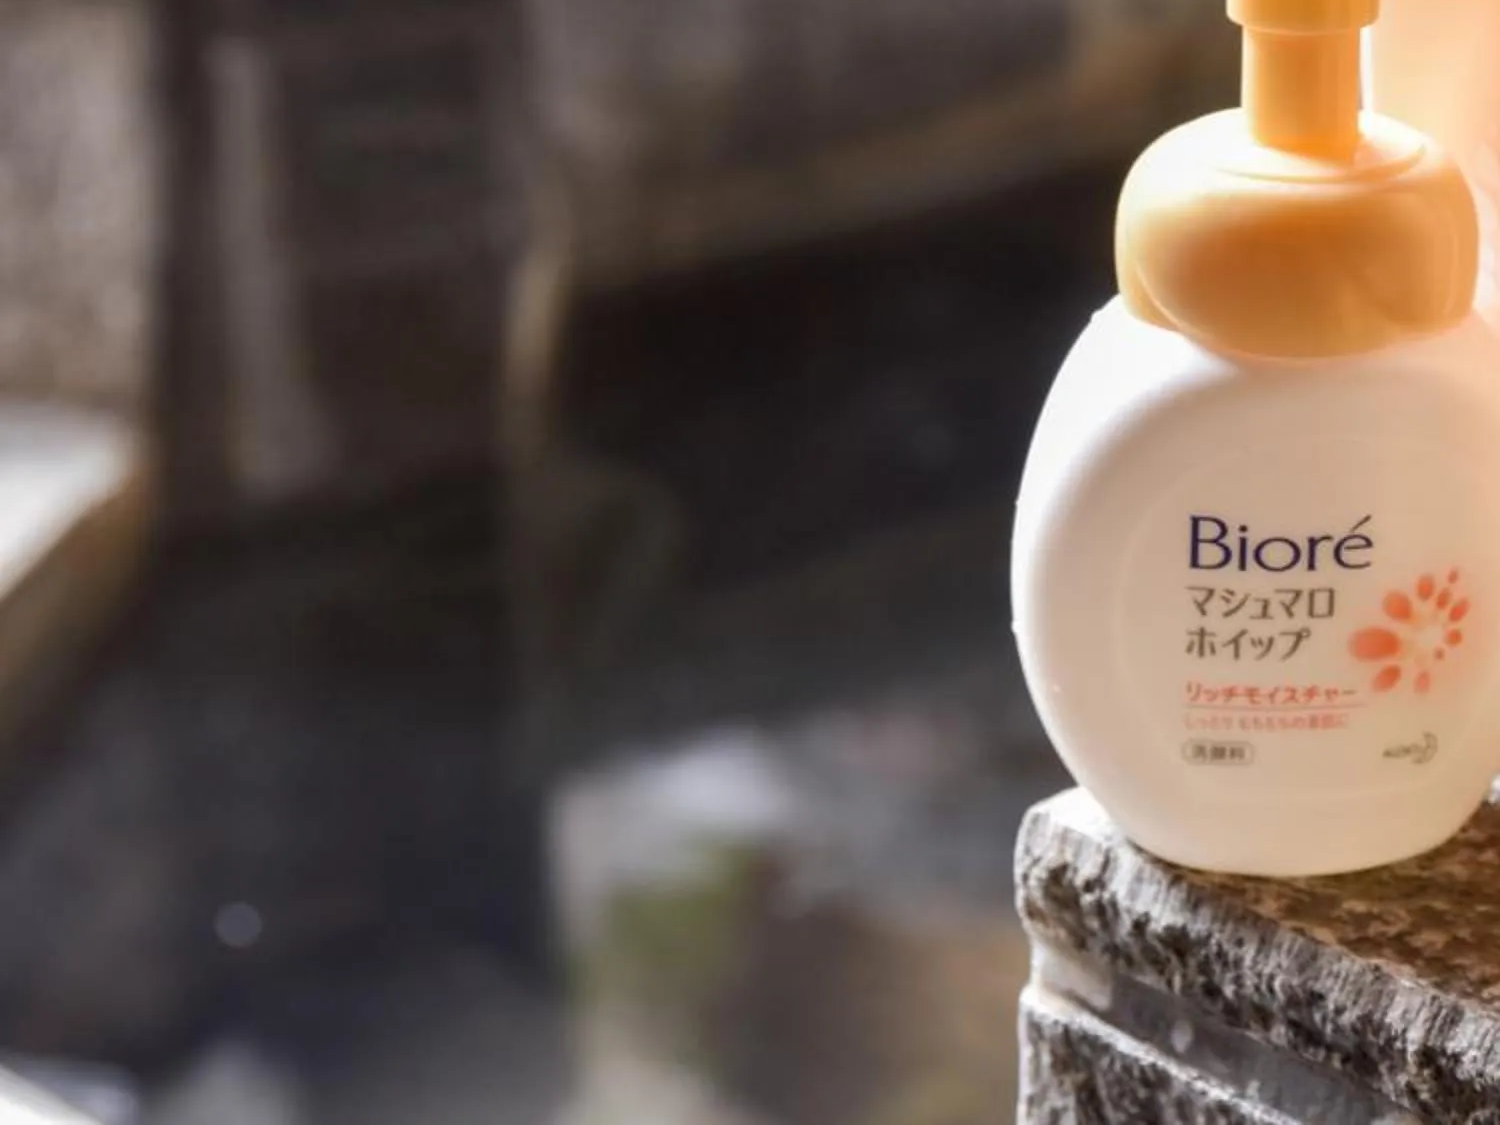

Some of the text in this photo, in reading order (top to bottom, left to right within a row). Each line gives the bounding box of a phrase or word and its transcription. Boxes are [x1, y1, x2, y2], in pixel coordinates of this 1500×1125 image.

[1188, 513, 1374, 573] Bioré
[1185, 585, 1336, 620] マシュマロ
[1185, 626, 1312, 661] ホイップ
[1186, 680, 1358, 705] リッチモイスチャー
